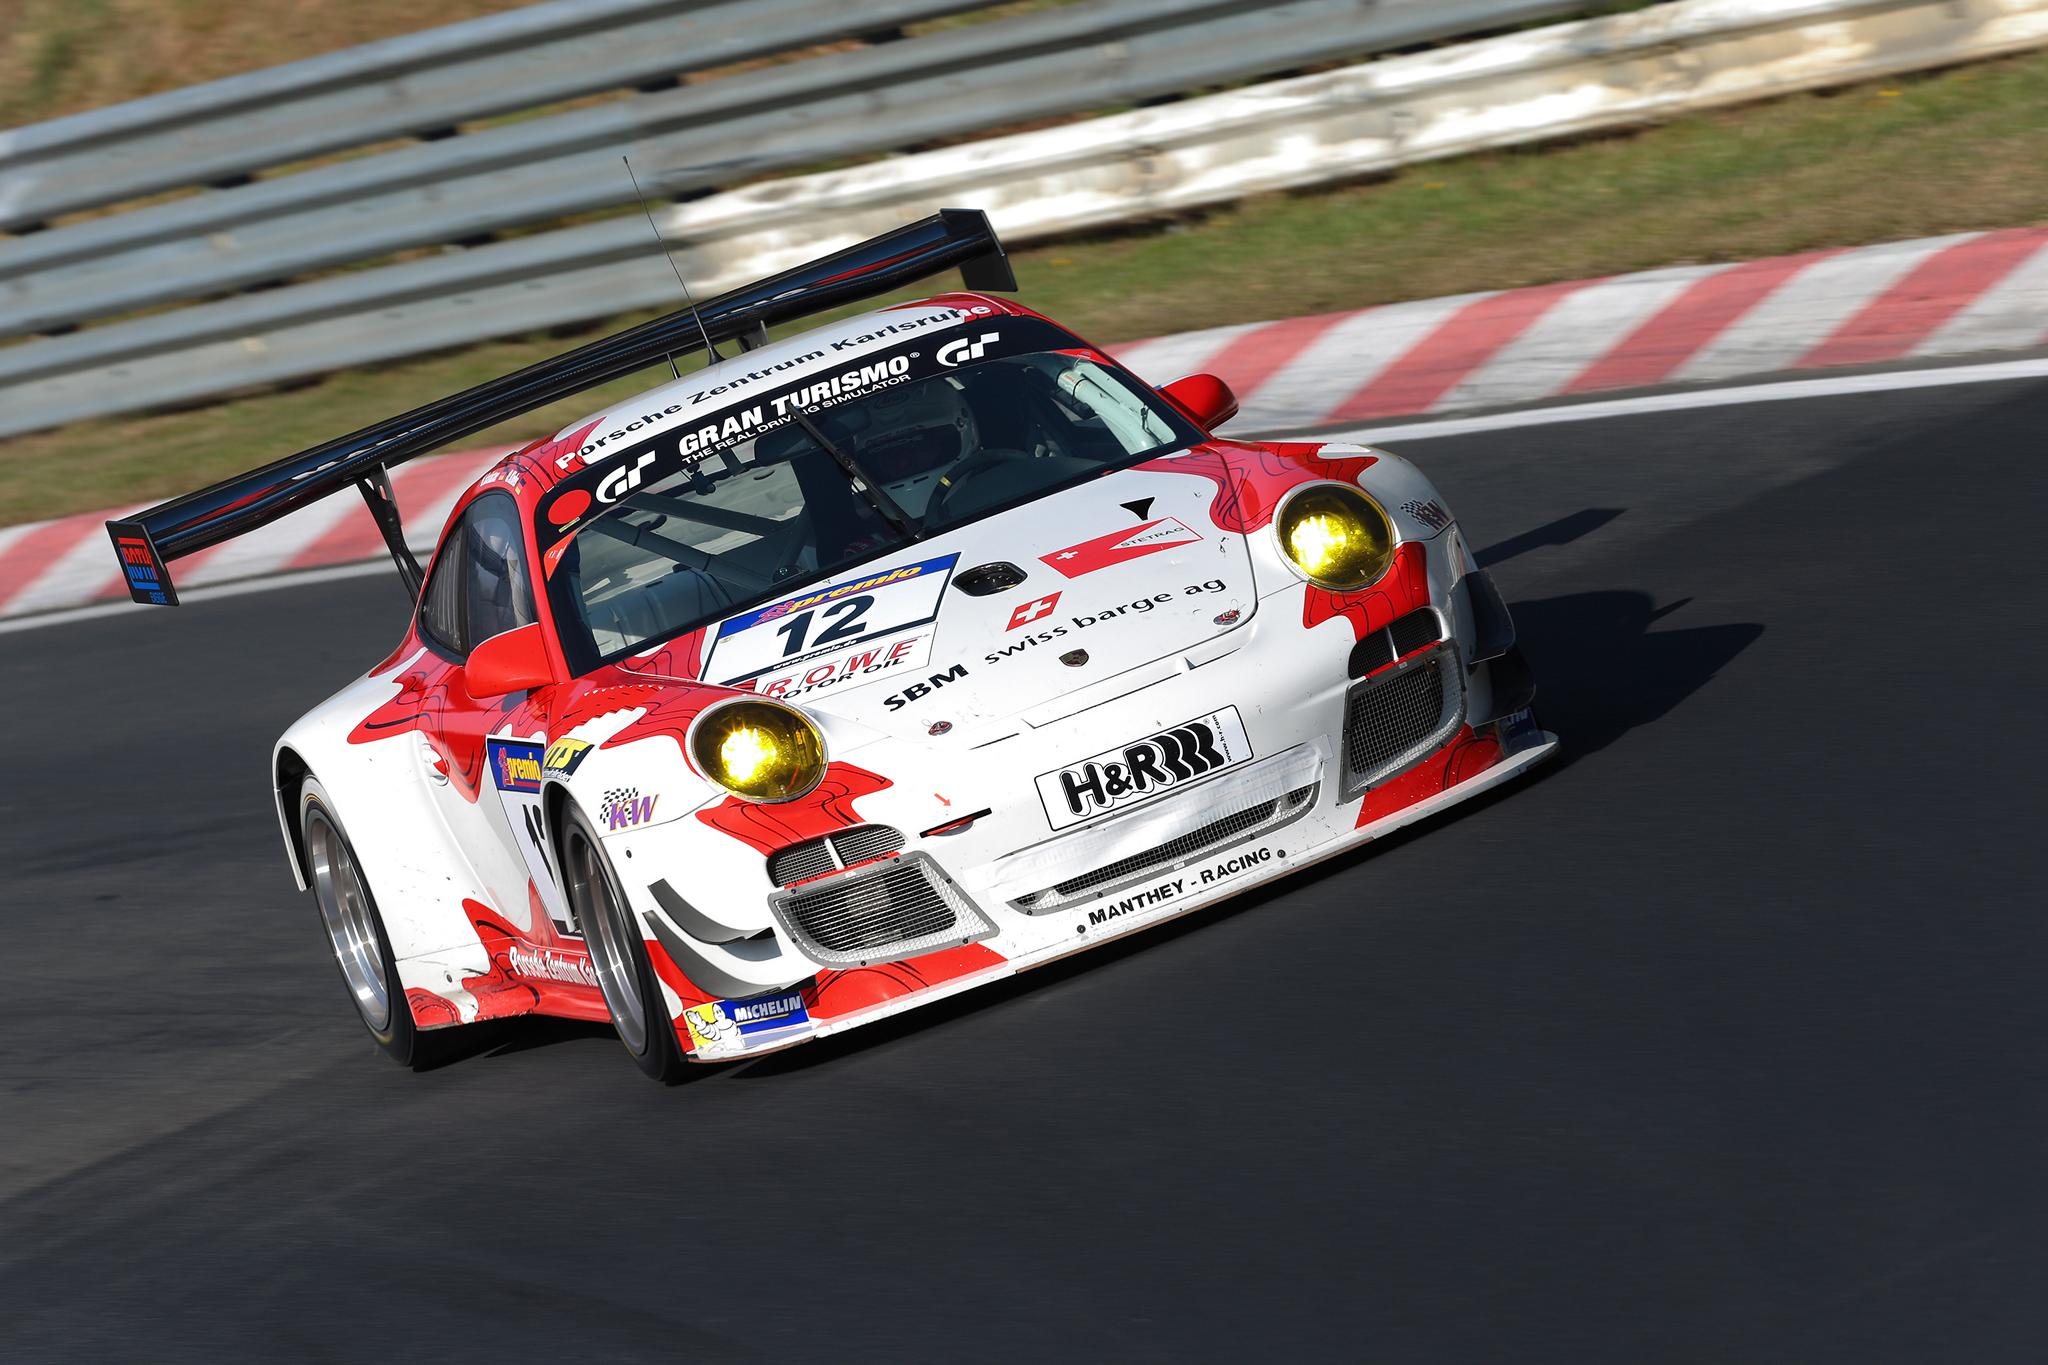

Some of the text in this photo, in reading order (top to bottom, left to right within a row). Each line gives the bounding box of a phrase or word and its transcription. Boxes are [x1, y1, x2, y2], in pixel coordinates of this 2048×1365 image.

[554, 305, 992, 470] Porsche Zentrum Karlsruhe
[678, 405, 764, 456] GRAN
[681, 373, 912, 464] THE REAL DRIVG SIMULATOR
[776, 594, 875, 657] 12
[883, 577, 1228, 712] SBM swiss barge ag
[765, 638, 918, 697] ROWE
[862, 657, 906, 674] OIL
[506, 751, 542, 786] premio
[609, 793, 660, 832] KW
[1088, 878, 1191, 926] MANTHEY
[1200, 847, 1272, 884] RACING
[509, 945, 551, 980] Porsche
[545, 950, 588, 985] Zentrum
[733, 995, 801, 1022] MICHELIN
